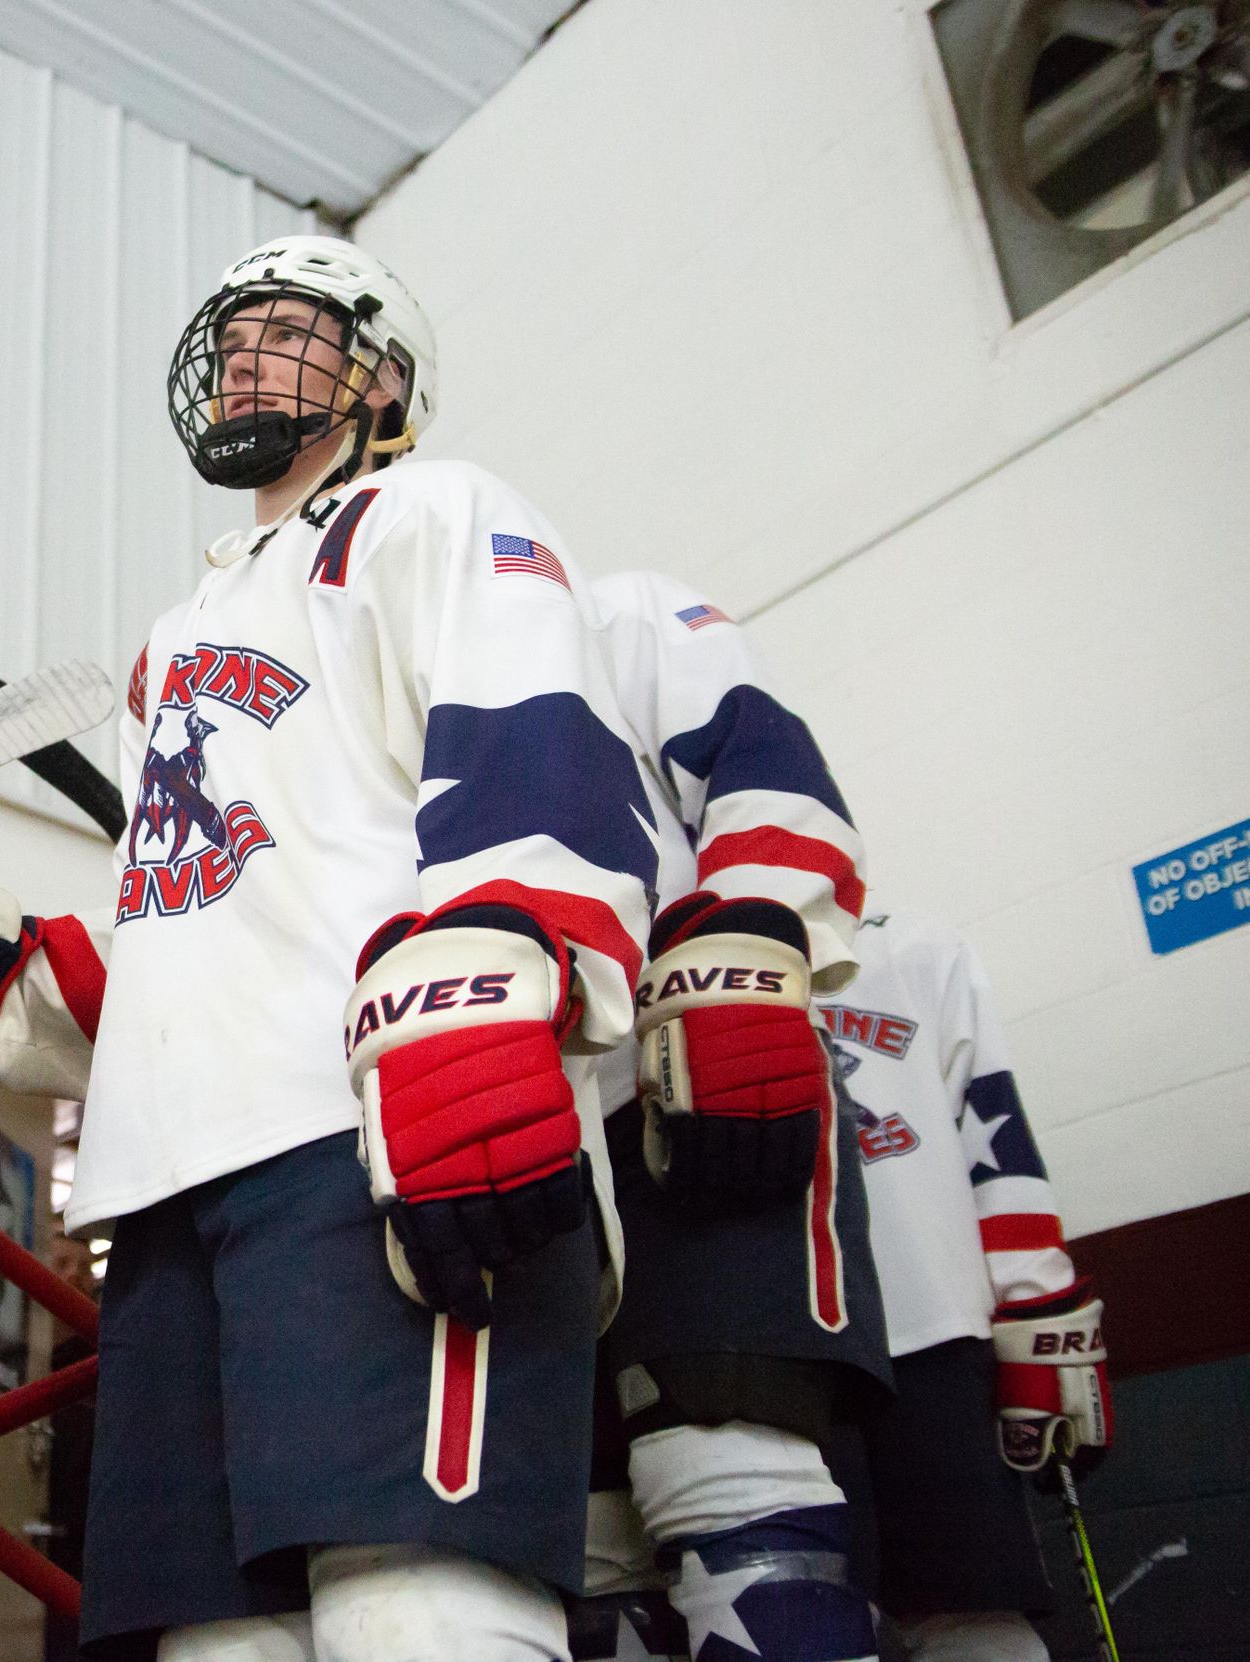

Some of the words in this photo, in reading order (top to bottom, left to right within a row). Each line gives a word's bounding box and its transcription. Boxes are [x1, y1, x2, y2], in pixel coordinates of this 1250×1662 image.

[232, 249, 287, 273] CCM
[1149, 859, 1186, 889] NO
[1147, 887, 1180, 916] OF
